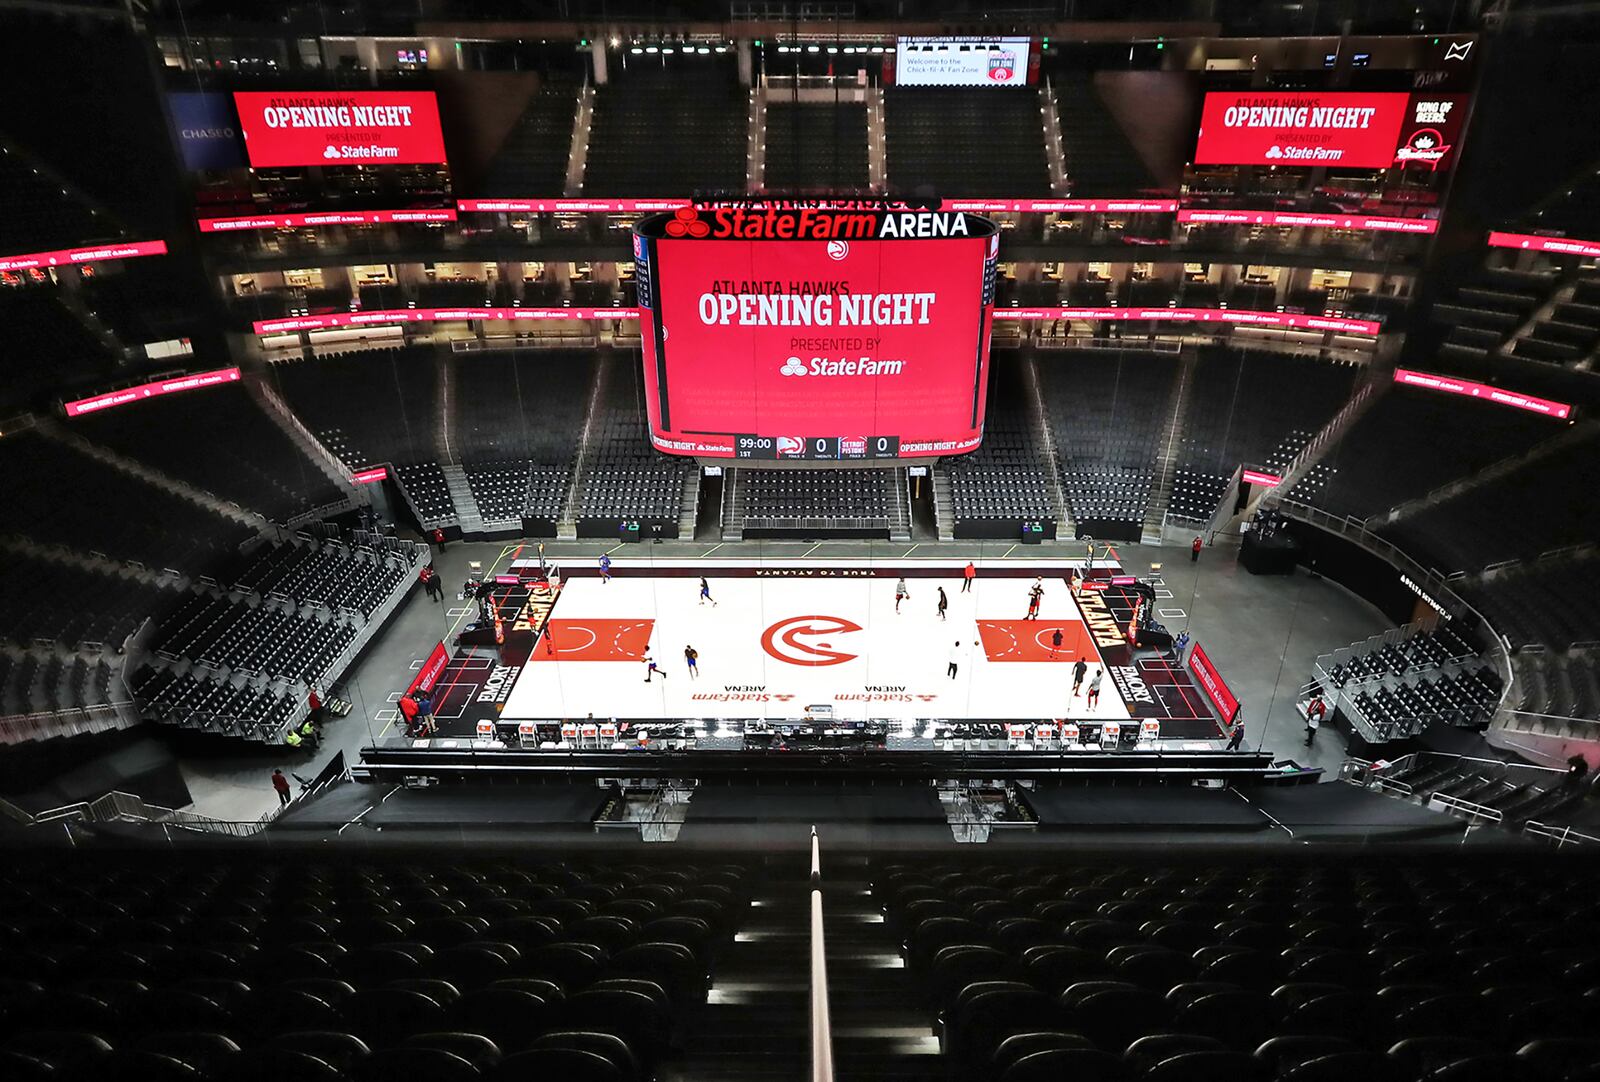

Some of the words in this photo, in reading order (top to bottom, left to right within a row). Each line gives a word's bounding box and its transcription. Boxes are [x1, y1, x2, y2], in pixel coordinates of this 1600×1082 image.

[1416, 102, 1439, 113] KING
[1439, 102, 1454, 113] OF
[264, 106, 351, 128] OPENING
[354, 106, 412, 127] NIGHT
[1224, 106, 1308, 128] OPENING
[1309, 107, 1376, 129] NIGHT
[182, 128, 224, 140] CHASE
[879, 212, 968, 238] ARENA
[711, 280, 783, 295] ATLANTA
[788, 280, 850, 296] HAWKS
[698, 292, 833, 326] OPENING
[839, 292, 936, 326] NIGHT
[790, 338, 862, 351] PRESENTED
[866, 338, 882, 350] BY
[740, 438, 771, 448] 99:00
[816, 438, 826, 452] 0
[877, 438, 888, 452] 0
[900, 442, 932, 452] OPENING
[934, 442, 956, 450] NIGHT
[1072, 588, 1126, 648] ATLANTA
[476, 664, 512, 702] EMORY
[1118, 666, 1154, 704] EMORY
